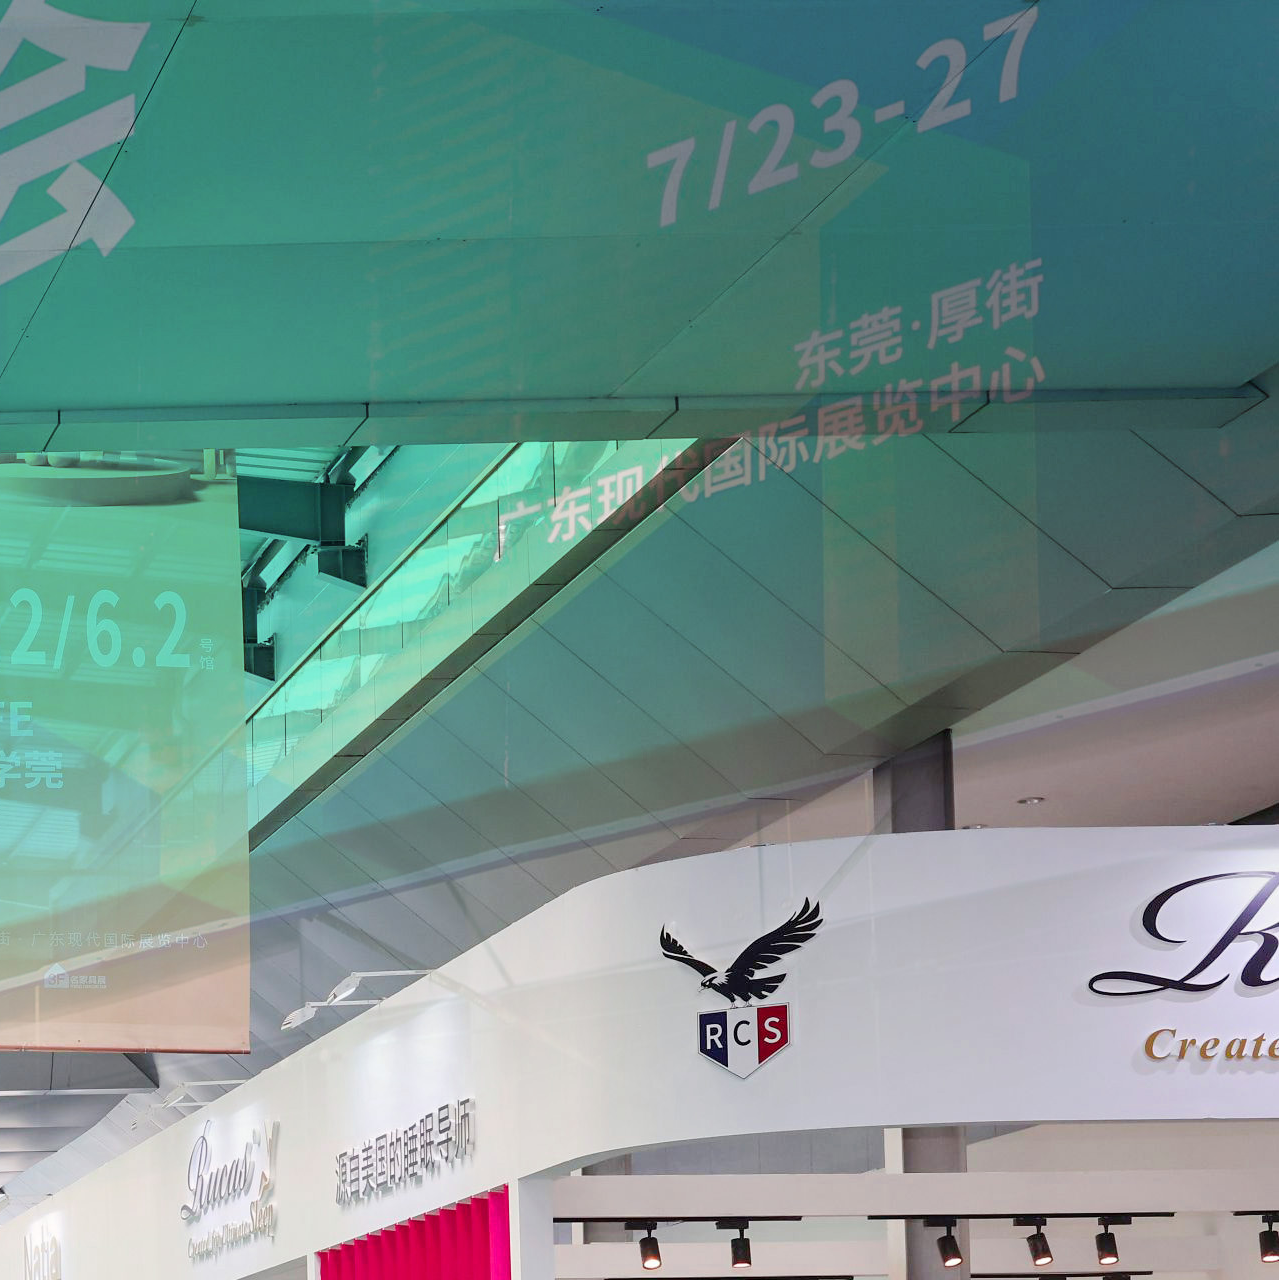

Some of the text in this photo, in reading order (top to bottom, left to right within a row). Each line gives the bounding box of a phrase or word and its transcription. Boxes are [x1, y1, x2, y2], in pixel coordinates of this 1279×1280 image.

[646, 7, 1039, 227] 7/23-27
[706, 1016, 782, 1051] RCS
[335, 1097, 471, 1206] 源自美国的睡眠导师
